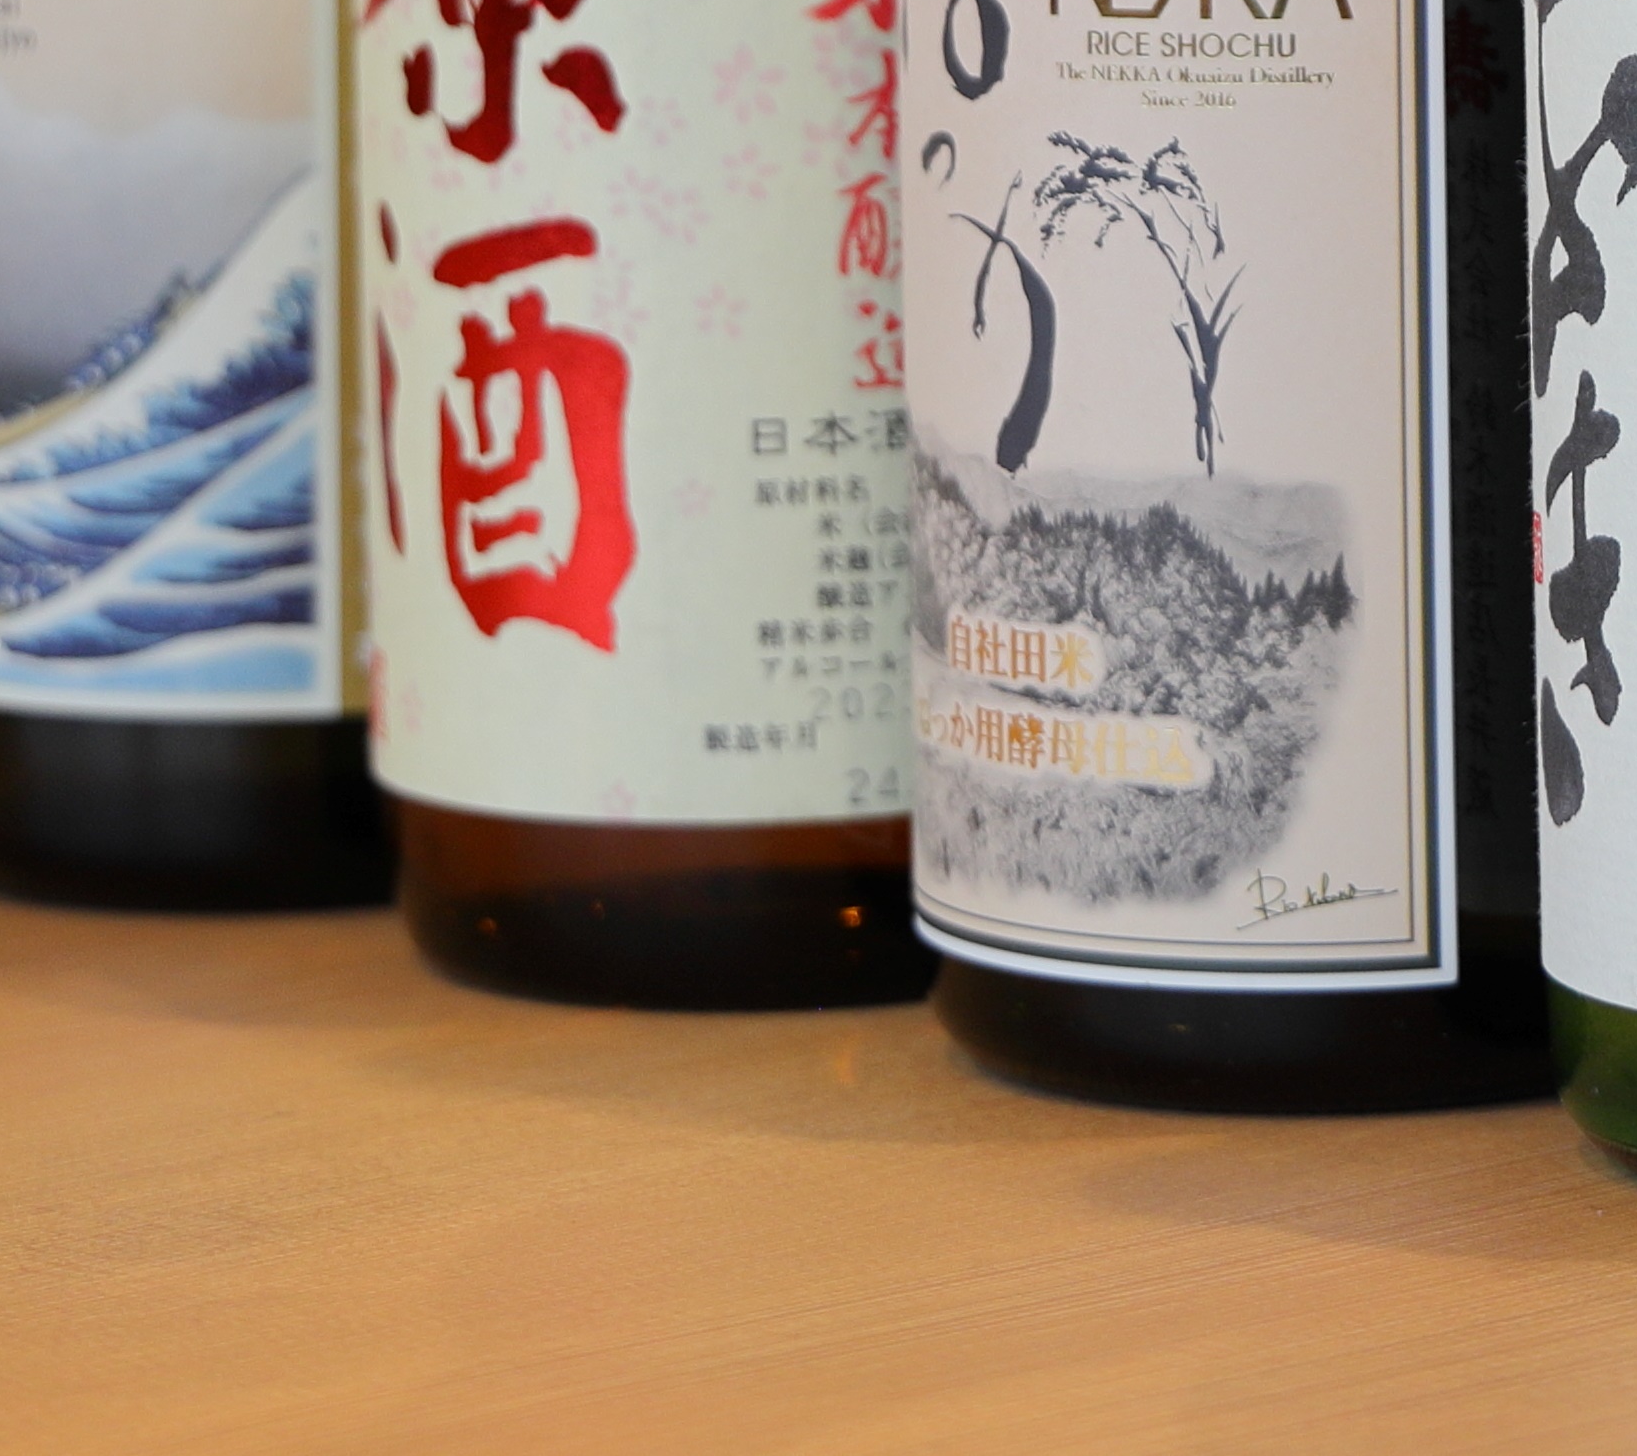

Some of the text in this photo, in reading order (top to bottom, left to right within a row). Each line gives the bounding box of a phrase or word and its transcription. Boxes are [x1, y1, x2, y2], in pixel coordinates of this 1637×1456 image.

[1087, 30, 1297, 58] RICE SHOCHU
[1056, 61, 1336, 88] The NEKKA Okuaizu Distillery
[1141, 91, 1237, 108] Since 2016
[950, 613, 1094, 689] 自社田米
